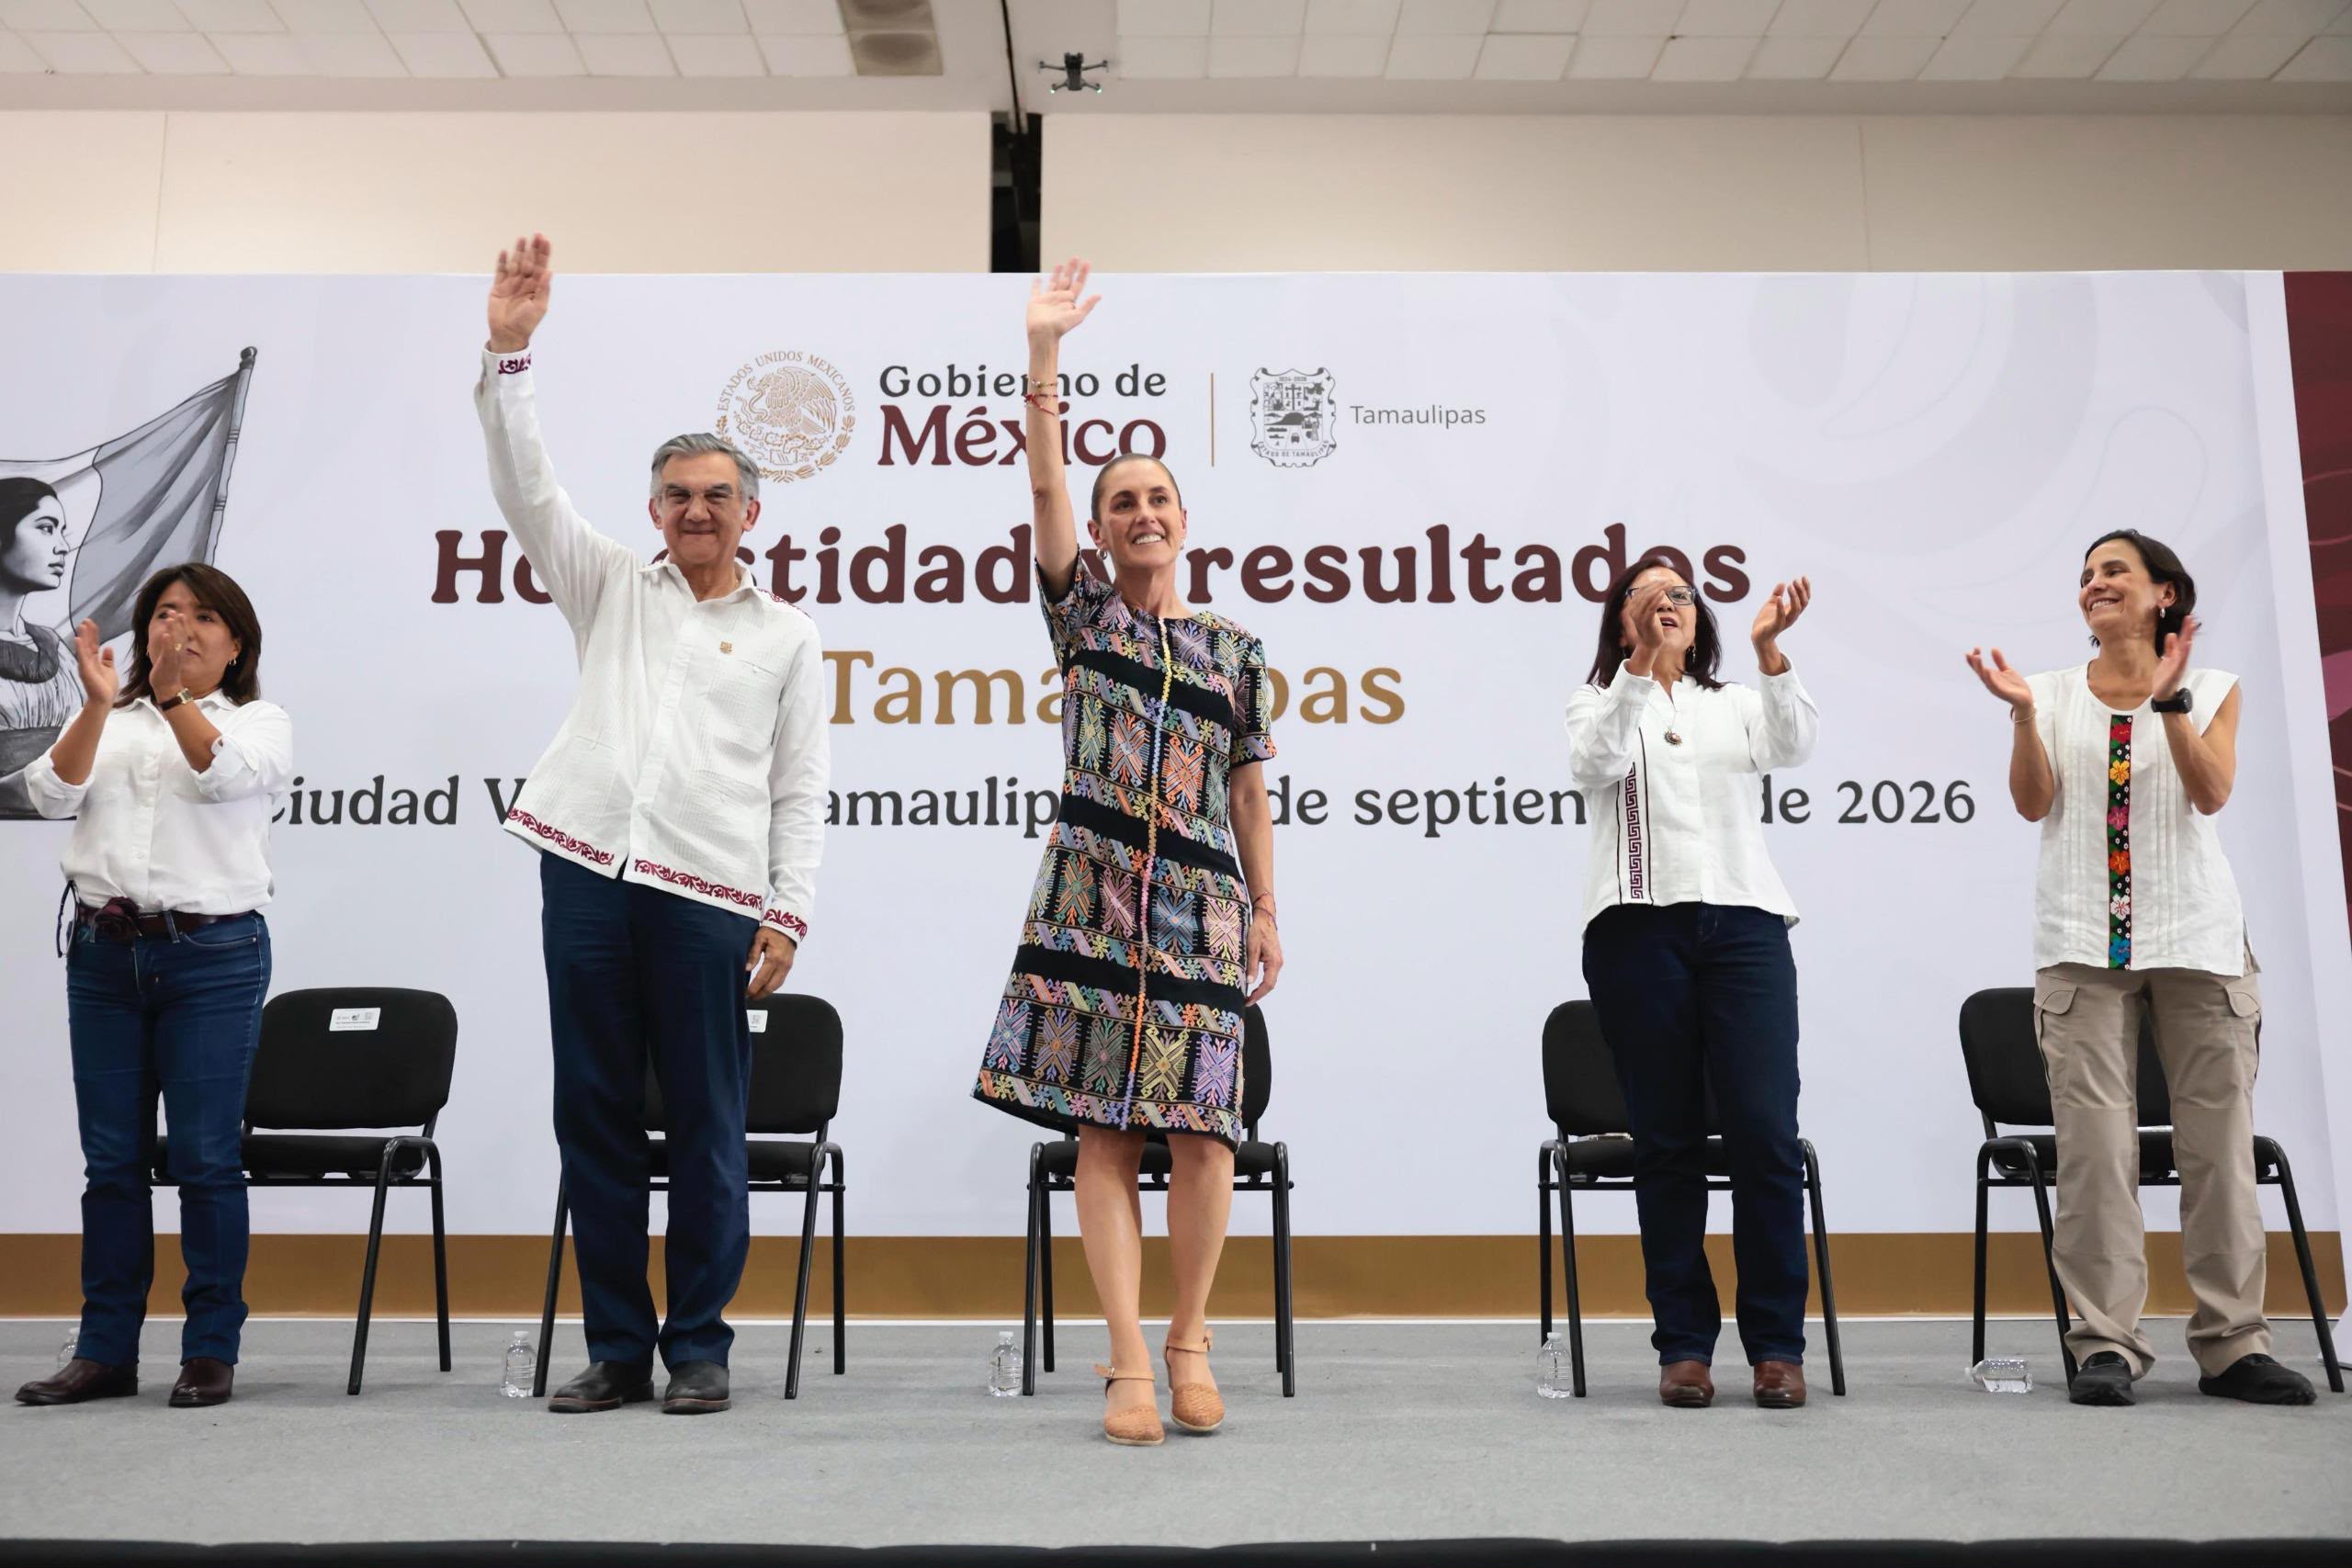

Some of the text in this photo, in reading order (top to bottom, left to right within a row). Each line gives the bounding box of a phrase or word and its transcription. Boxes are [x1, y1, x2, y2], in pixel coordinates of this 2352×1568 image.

[717, 350, 855, 412] ESTADOS UNIDOS MEXICANOS
[1115, 364, 1167, 397] de
[877, 401, 1167, 467] México
[1350, 404, 1487, 430] Tamaulipas
[272, 774, 459, 826] iudad
[1267, 774, 1329, 825] de
[1837, 780, 1976, 825] 2026
